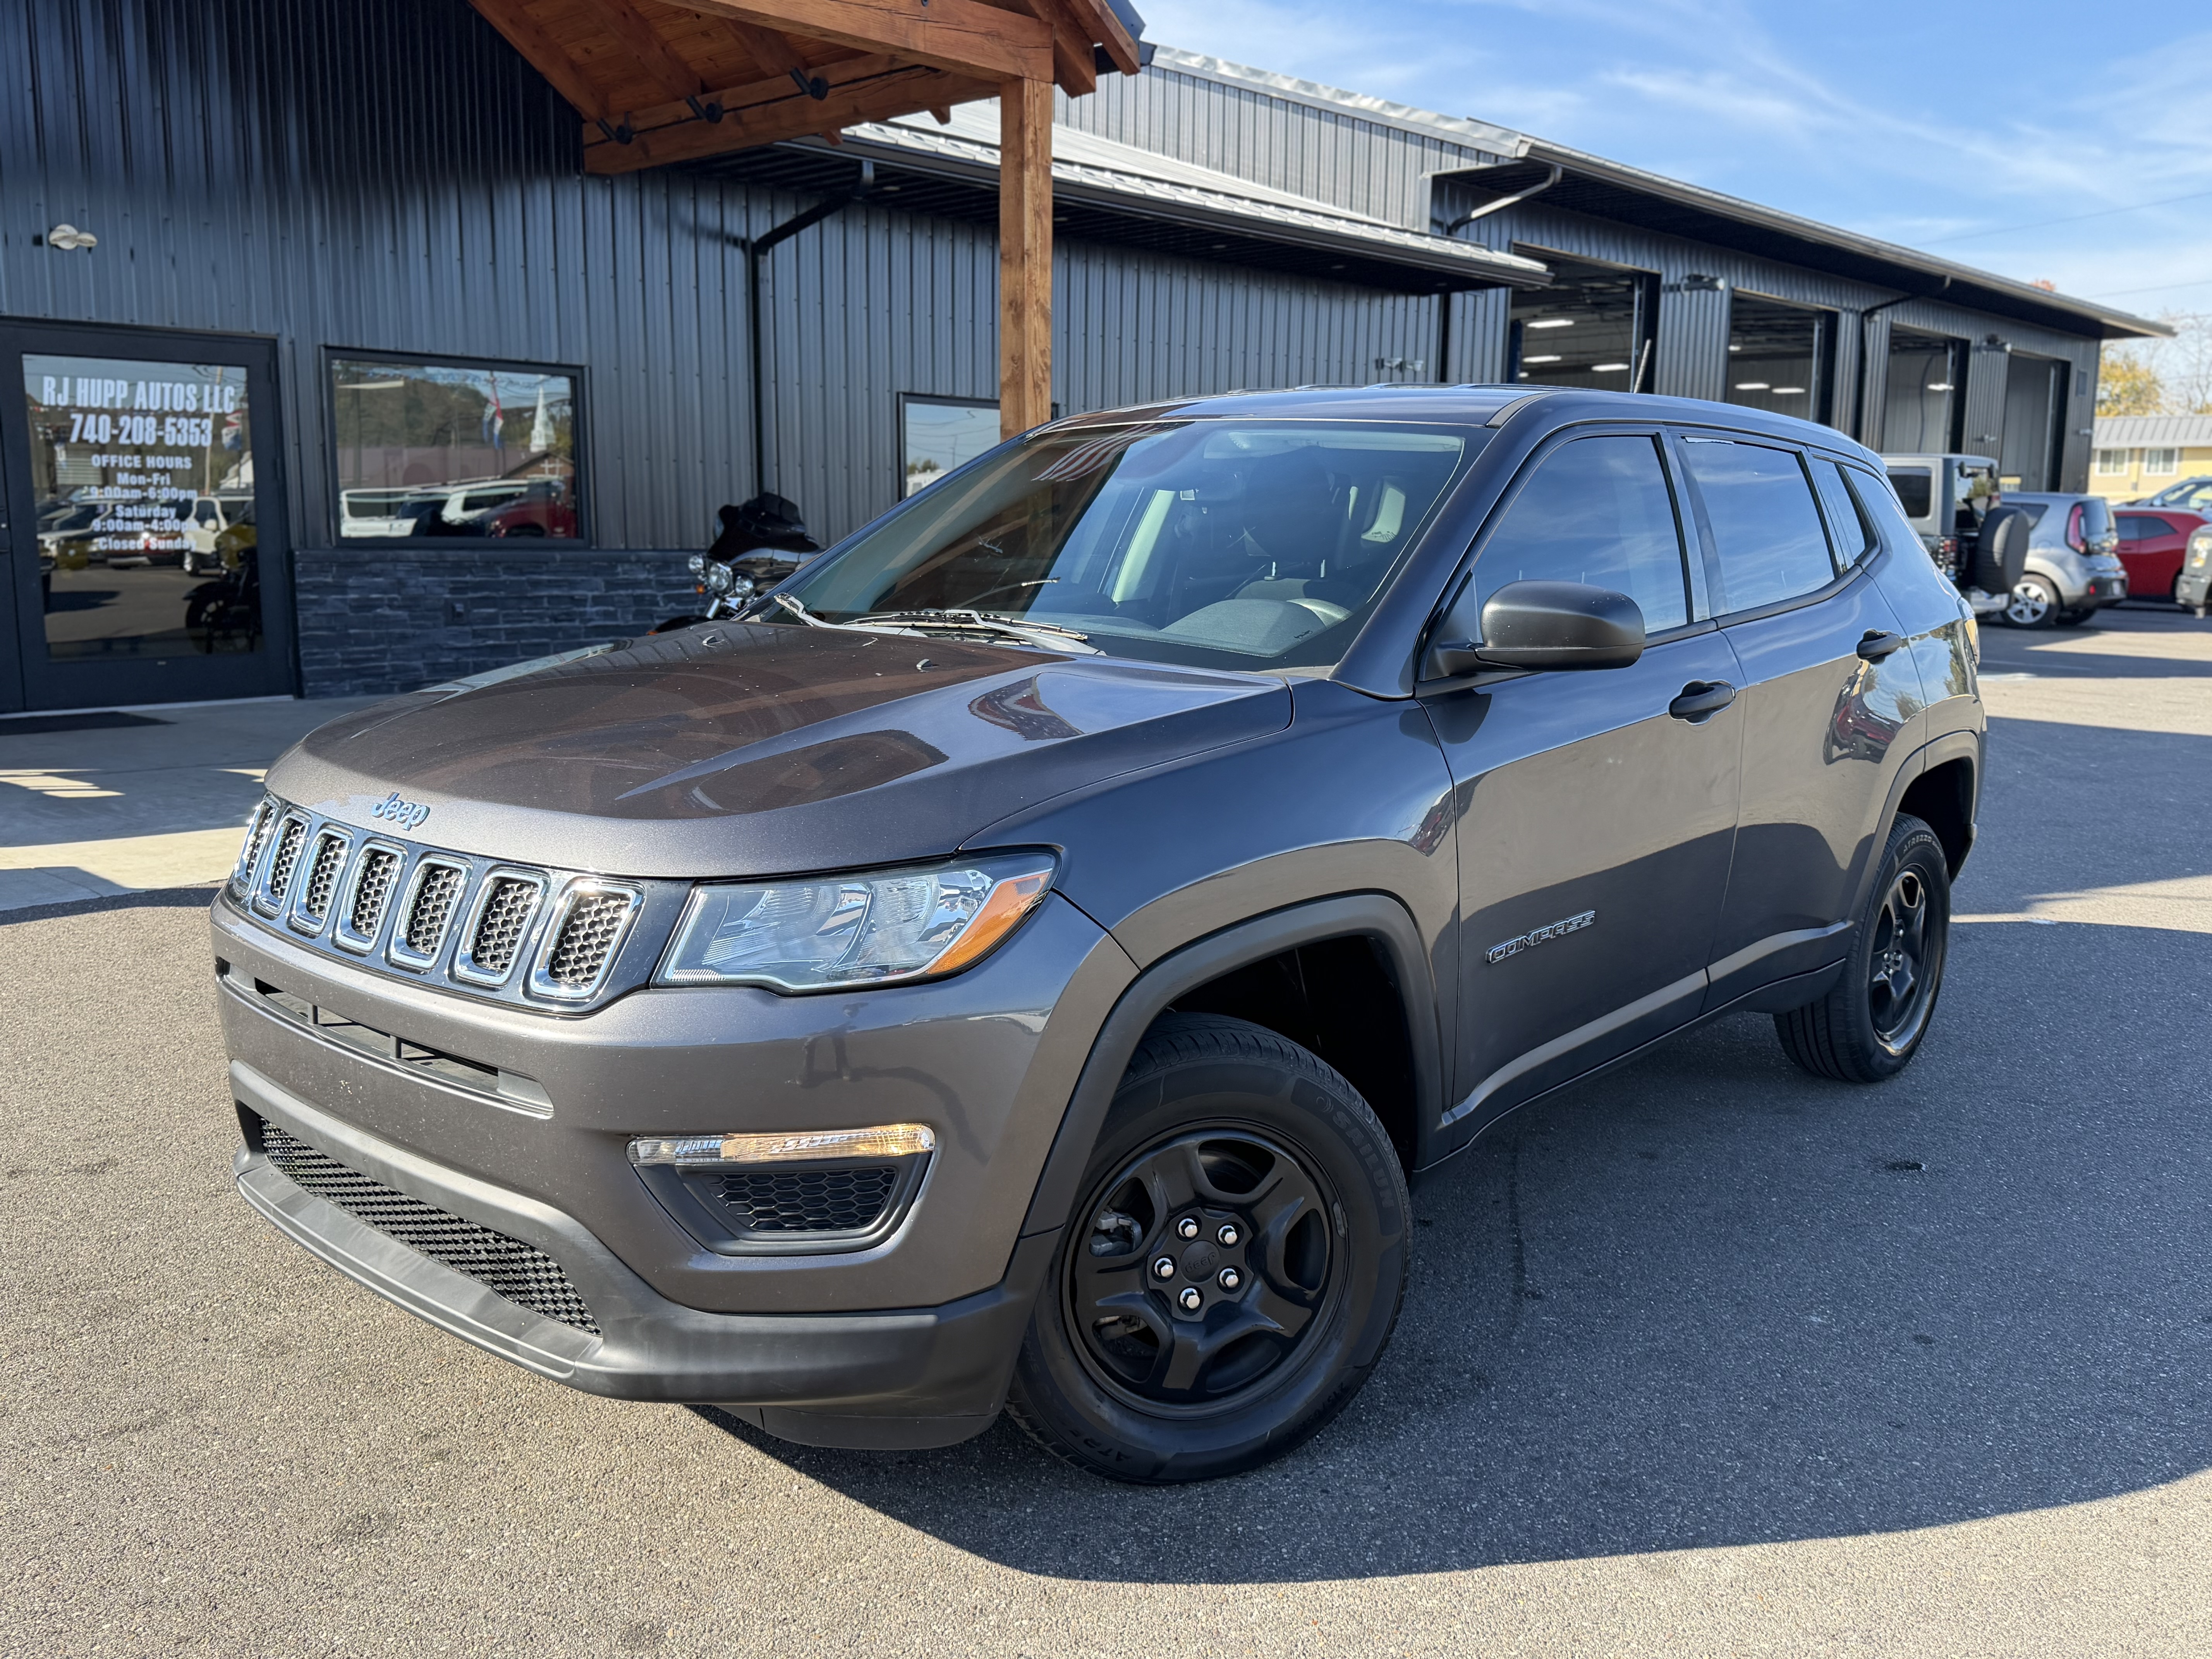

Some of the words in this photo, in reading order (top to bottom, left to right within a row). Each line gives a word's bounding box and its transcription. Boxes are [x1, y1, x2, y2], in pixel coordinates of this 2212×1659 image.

[43, 376, 69, 406] RJ
[77, 378, 128, 409] HUPP
[134, 381, 197, 412] AUTOS
[203, 385, 235, 414] LLC
[70, 414, 213, 447] 740-208-5353
[91, 454, 141, 468] OFFICE
[146, 456, 192, 469] HOURS
[117, 472, 170, 485] Mon-Fri
[90, 486, 198, 502] 9:00am-6:00pm
[115, 505, 176, 519] Saturday
[98, 537, 143, 550] Closed
[149, 537, 197, 551] Sunday
[371, 792, 430, 831] Jeep
[1485, 910, 1595, 964] COMPASS
[1332, 1111, 1395, 1208] SAILUN
[1185, 1252, 1216, 1273] Jeep
